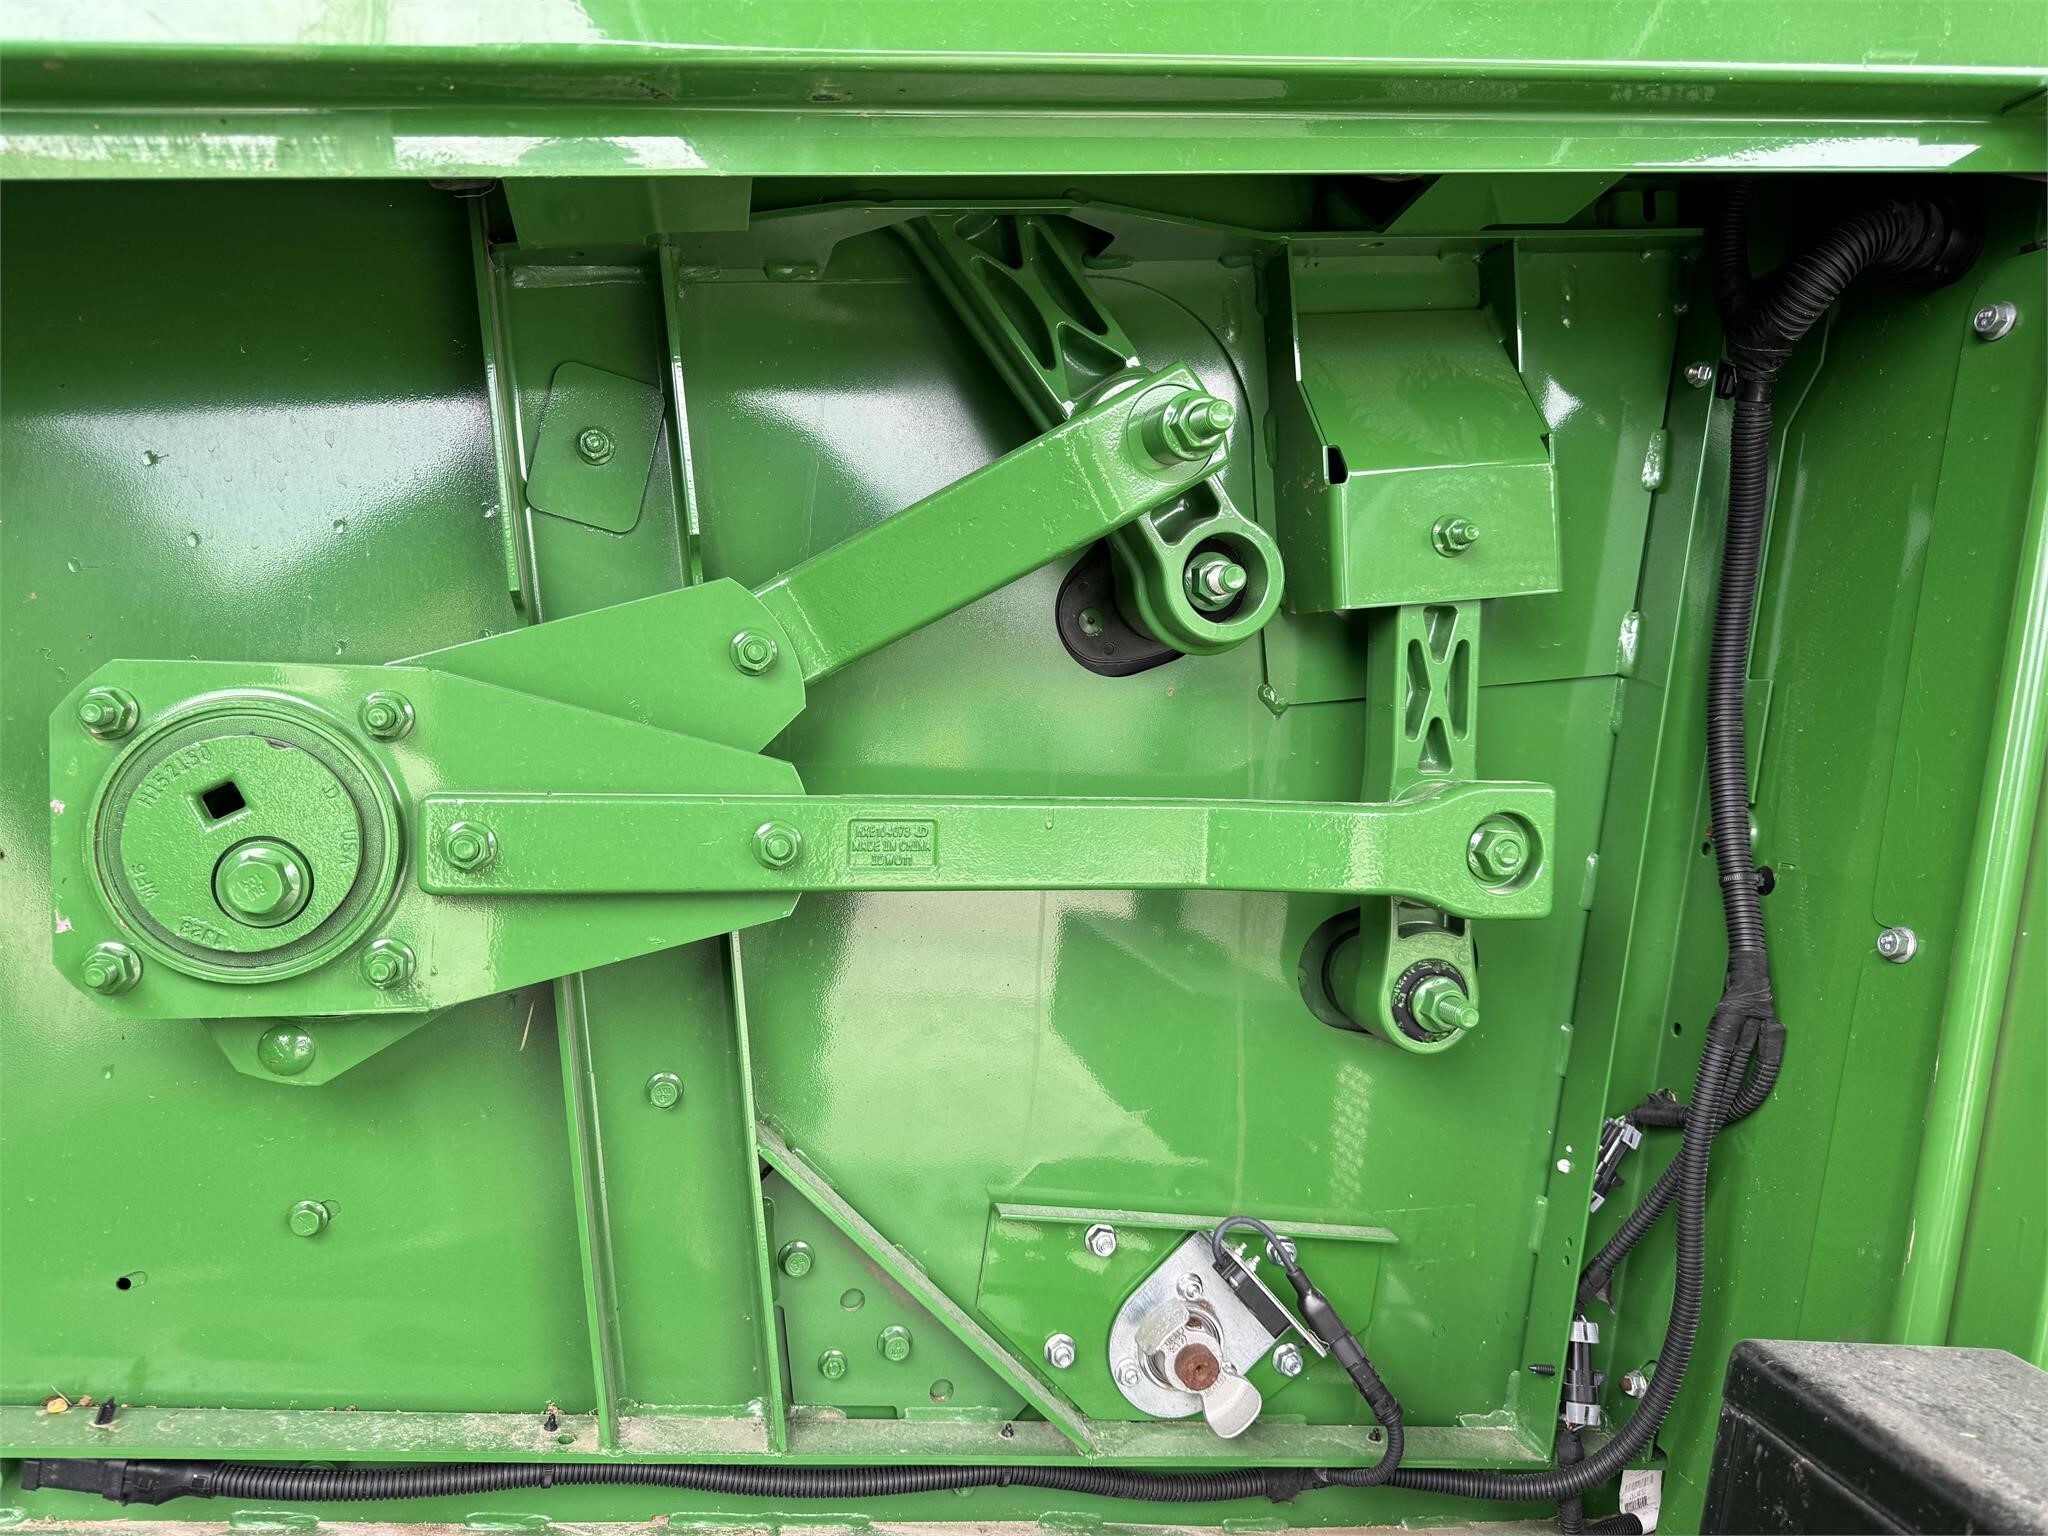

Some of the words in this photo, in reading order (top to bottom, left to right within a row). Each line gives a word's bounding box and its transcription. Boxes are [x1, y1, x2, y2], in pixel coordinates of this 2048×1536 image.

[339, 828, 358, 867] USA
[852, 839, 881, 852] MADE
[882, 839, 897, 852] IN
[899, 839, 932, 852] CHINA
